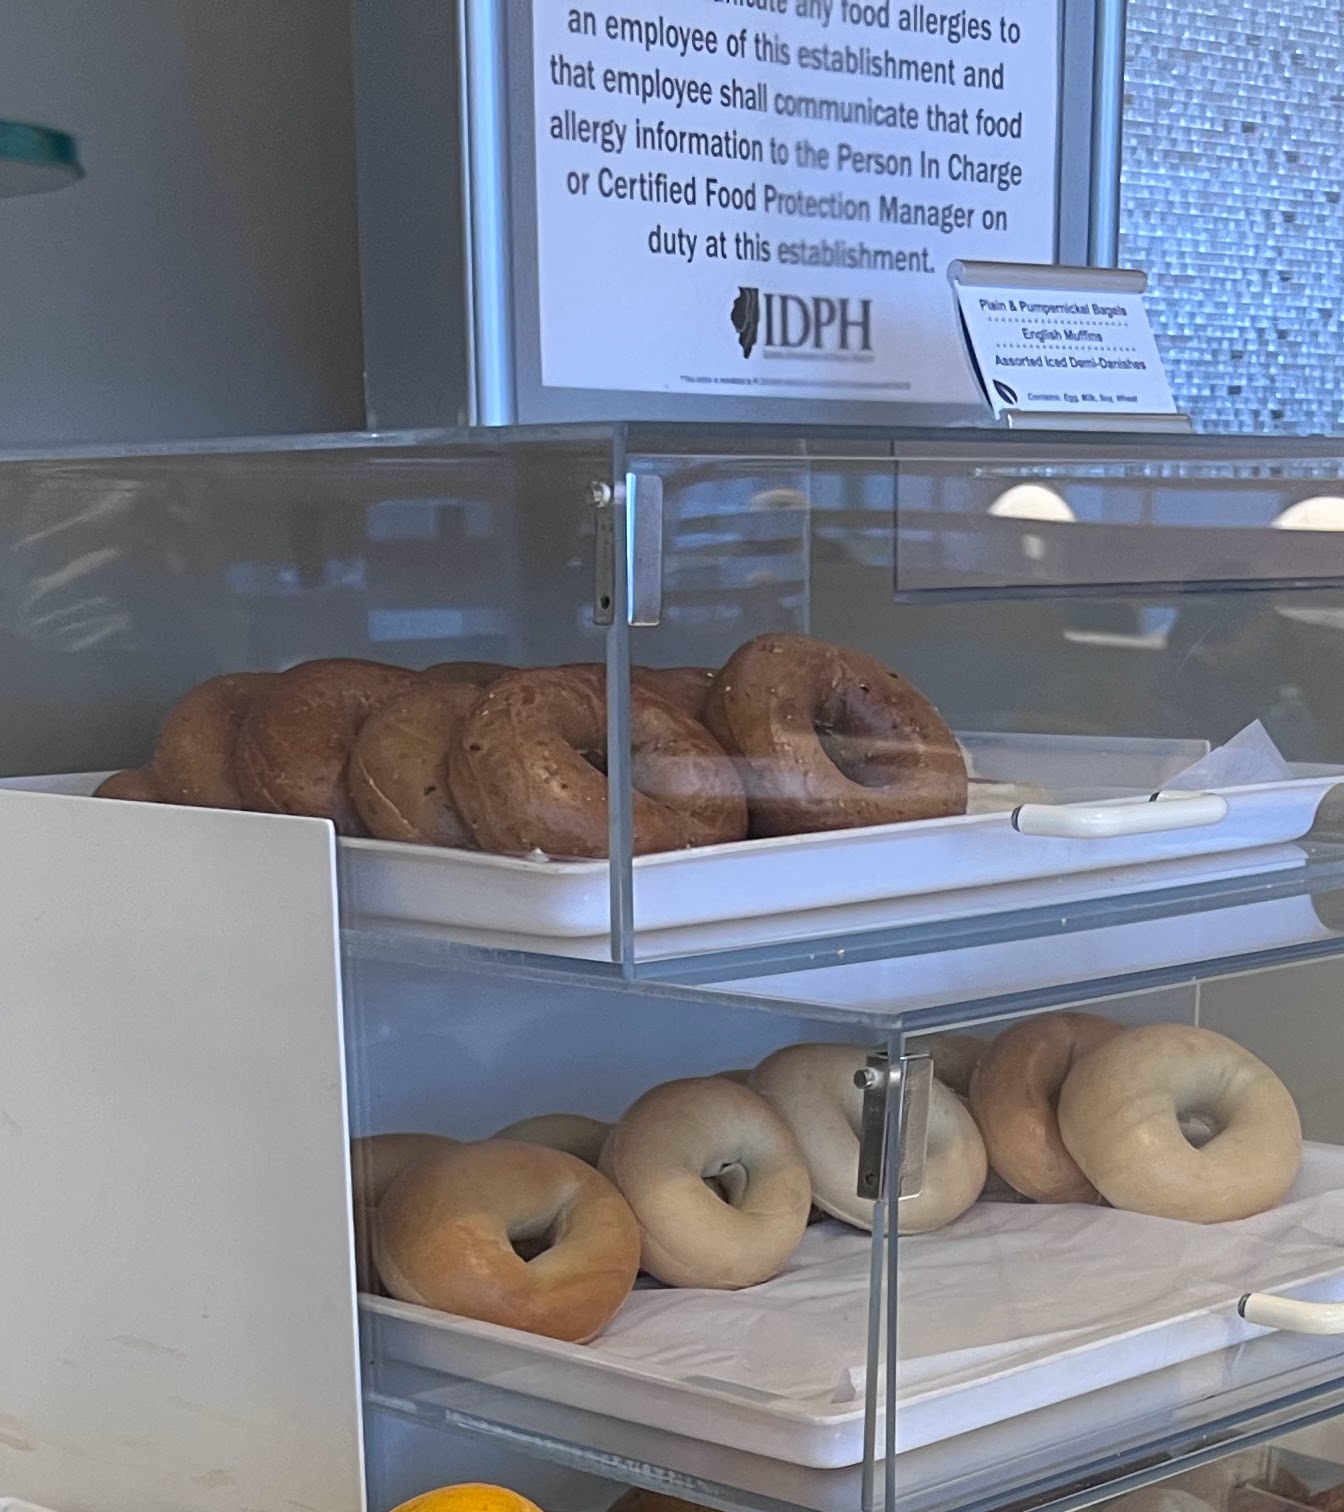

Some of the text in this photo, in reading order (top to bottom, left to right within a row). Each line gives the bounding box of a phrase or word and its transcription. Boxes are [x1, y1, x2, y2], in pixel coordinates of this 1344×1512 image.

[795, 0, 833, 28] any
[841, 0, 890, 28] food
[899, 4, 992, 44] allergies
[1000, 15, 1021, 44] to
[568, 9, 1004, 90] an employee of this establishment and
[550, 54, 1023, 139] that employee shall communicate that food
[550, 109, 1022, 192] allergy information to the Person In Charge
[567, 167, 1007, 234] or Certified Food Protection Manager on
[648, 224, 936, 274] duty at this establishment.
[764, 293, 873, 350] IDPH
[979, 299, 1007, 311] Plain
[1009, 299, 1017, 311] &
[1091, 304, 1128, 318] Bagels
[996, 355, 1043, 367] Assorted
[1044, 356, 1067, 367] Iced
[1022, 328, 1103, 343] English Muffins
